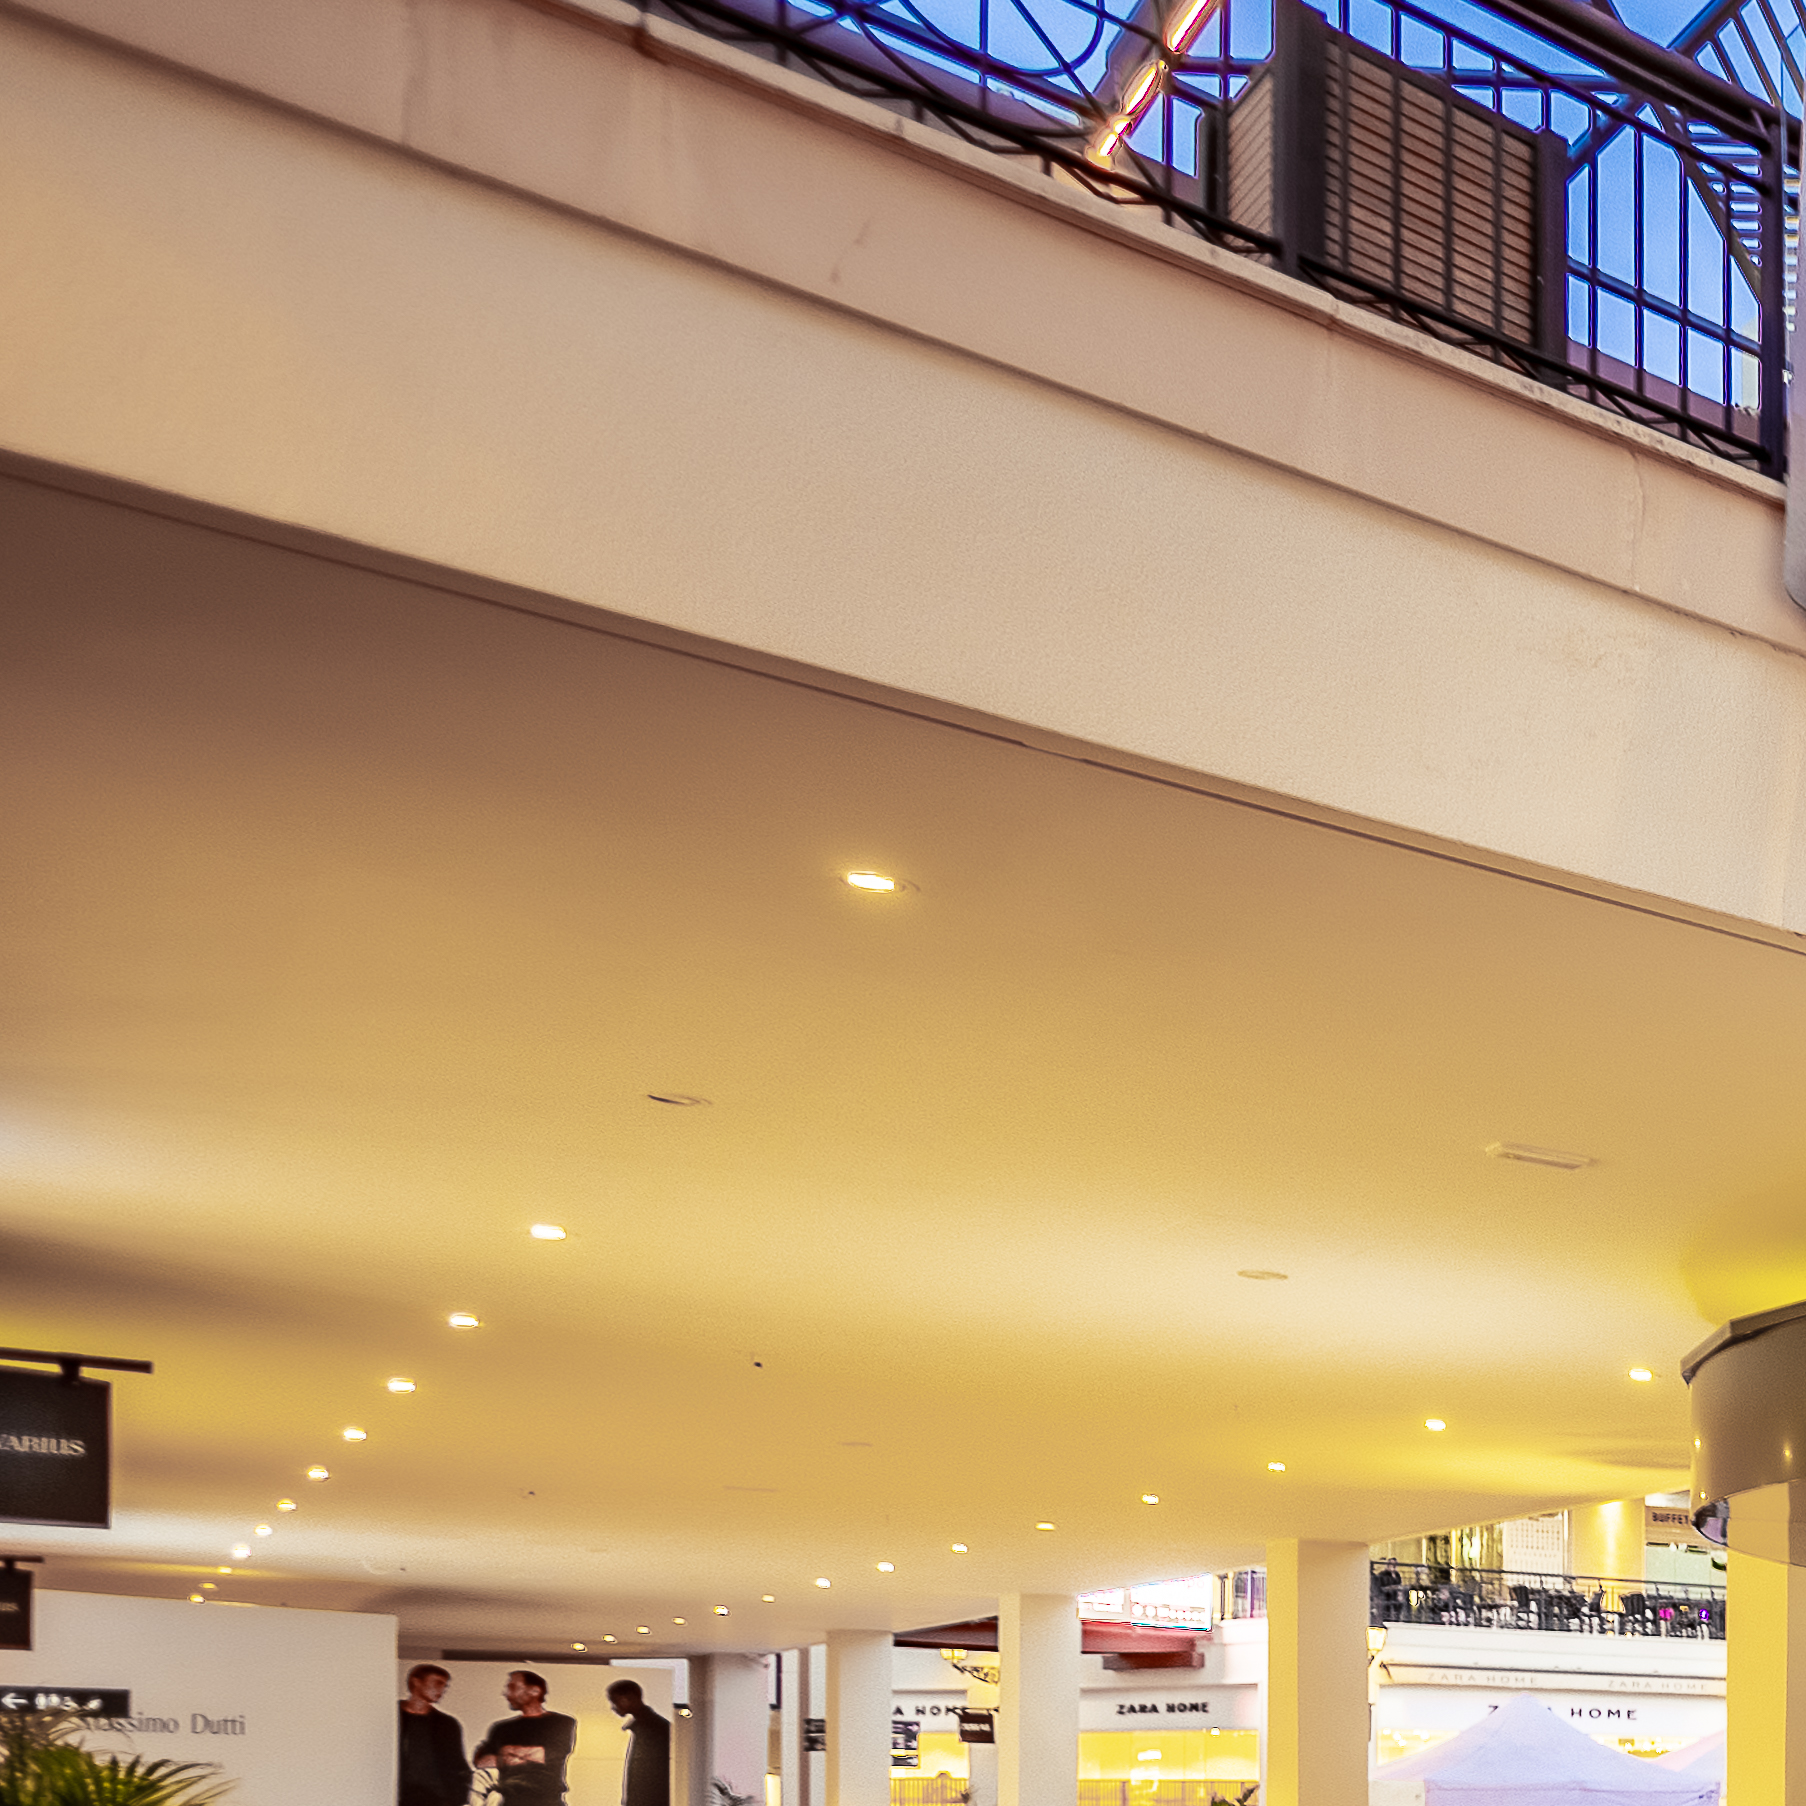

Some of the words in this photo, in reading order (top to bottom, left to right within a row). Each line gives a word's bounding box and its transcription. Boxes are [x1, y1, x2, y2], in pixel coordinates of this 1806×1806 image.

[1116, 1703, 1160, 1715] ZARA
[1166, 1701, 1210, 1714] HOME
[1571, 1707, 1637, 1720] HOME
[190, 1713, 247, 1735] Dutti
